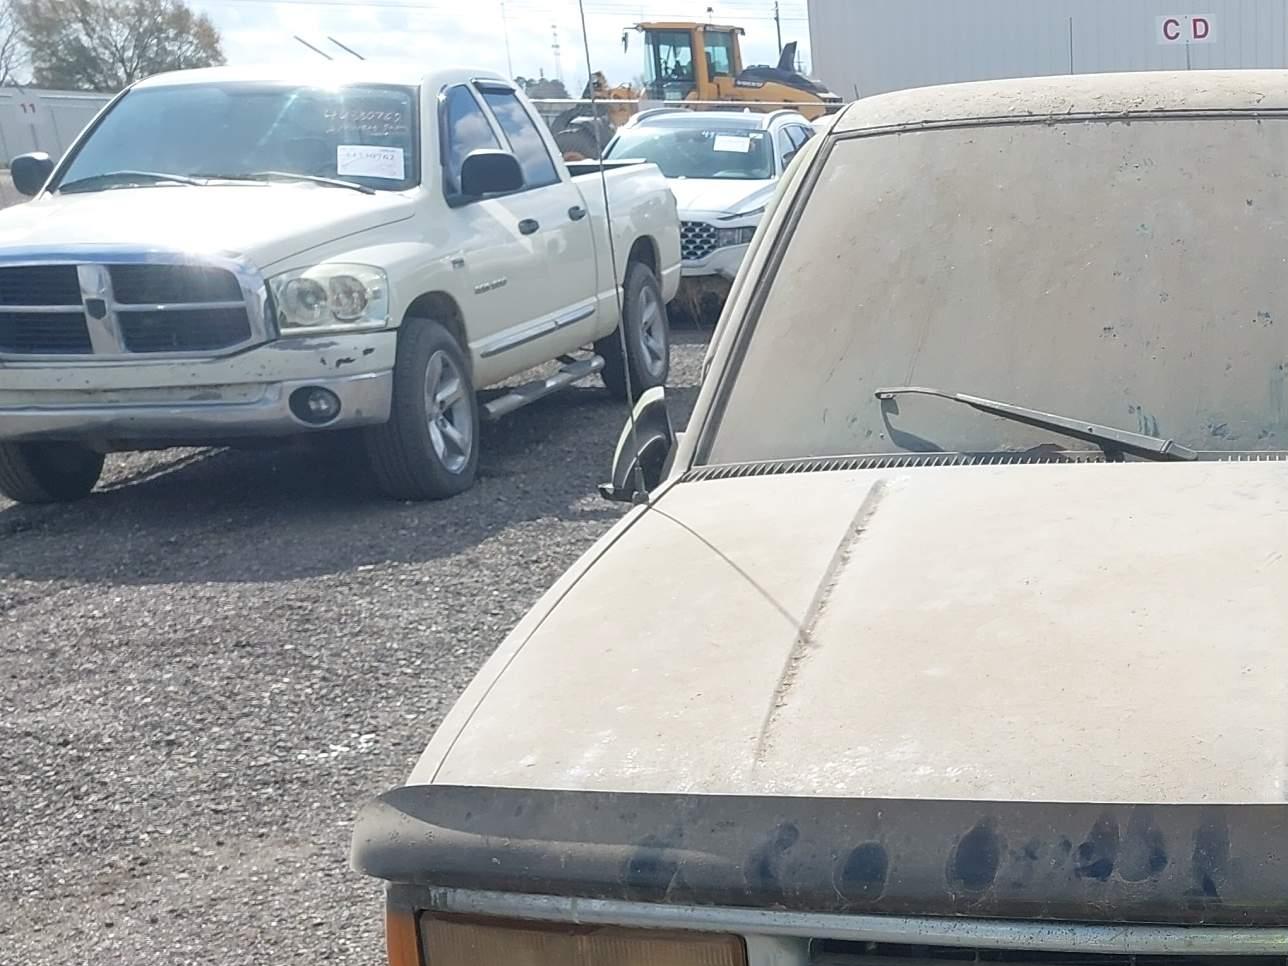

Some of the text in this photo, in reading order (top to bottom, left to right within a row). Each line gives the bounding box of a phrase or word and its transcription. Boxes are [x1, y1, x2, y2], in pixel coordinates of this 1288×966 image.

[1163, 18, 1209, 40] C D
[20, 103, 36, 113] 11
